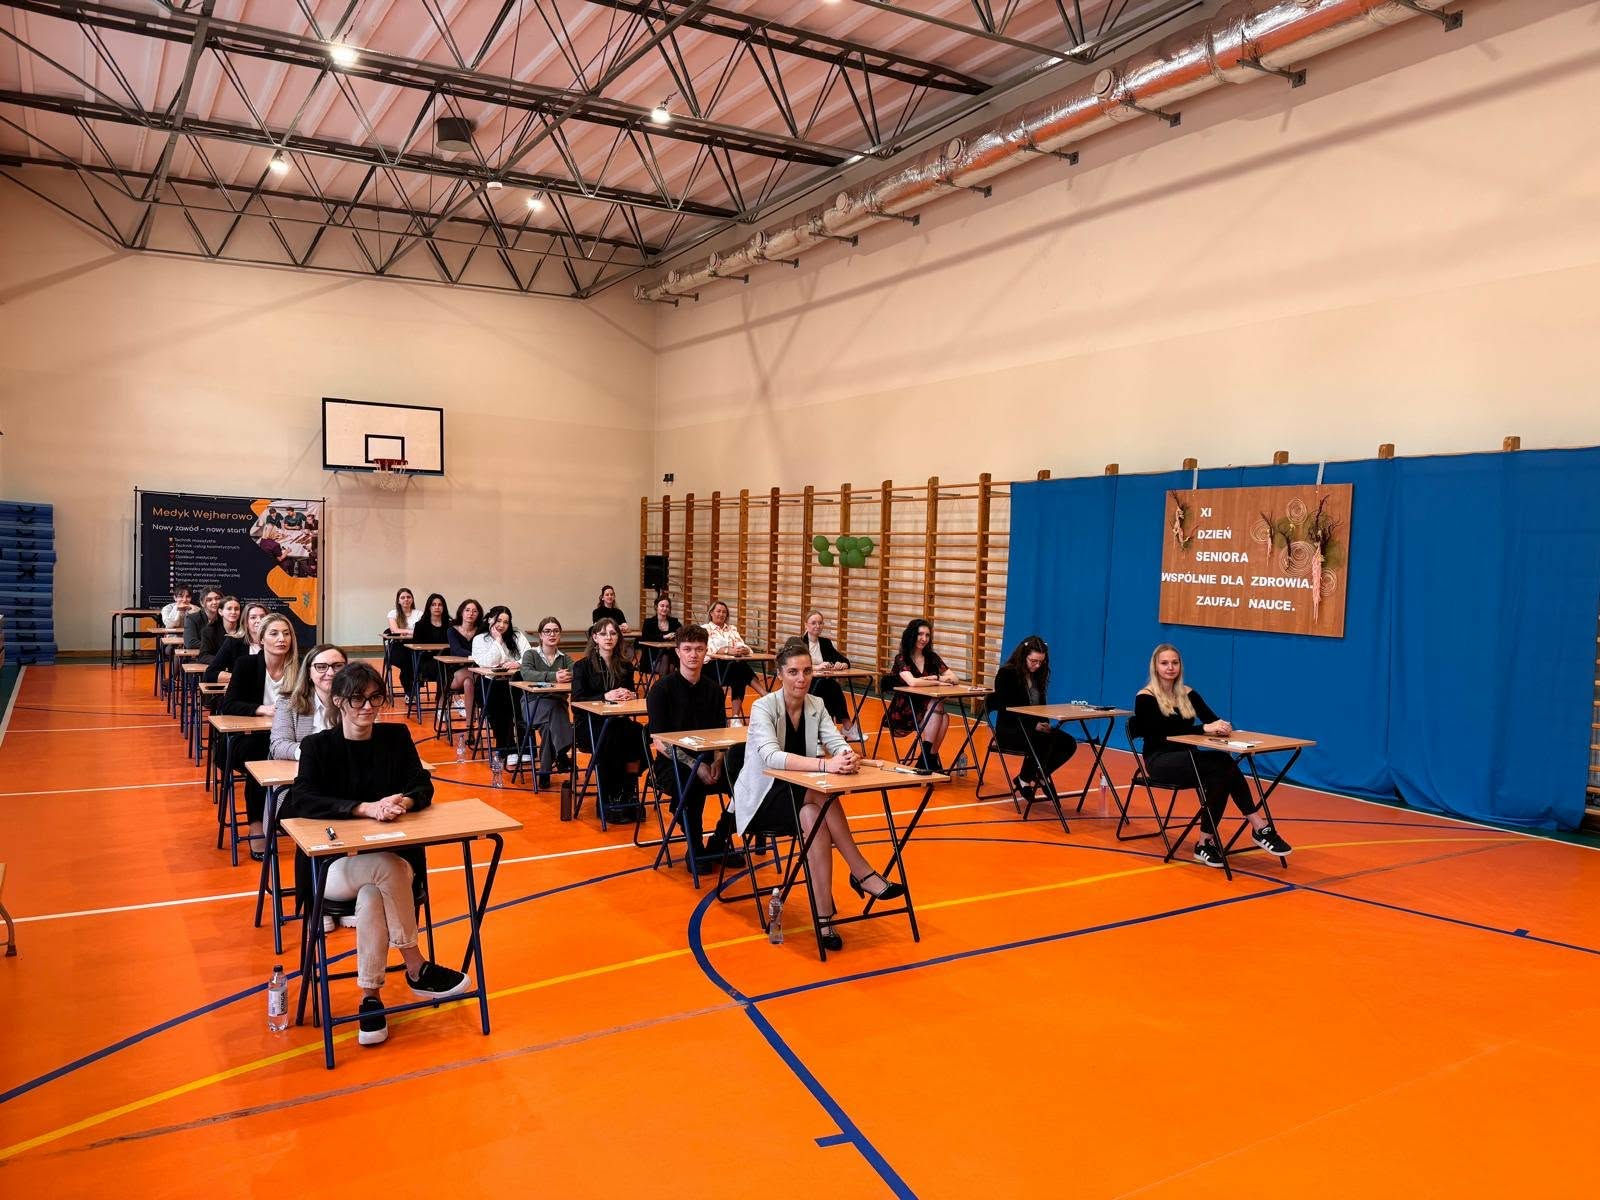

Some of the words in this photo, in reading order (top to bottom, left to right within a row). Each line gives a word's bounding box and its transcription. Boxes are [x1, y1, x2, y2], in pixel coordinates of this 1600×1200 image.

[152, 507, 190, 519] Medyk
[192, 509, 253, 520] Wejherowo
[1200, 507, 1212, 518] XI
[152, 524, 173, 532] Nowy
[1197, 527, 1232, 540] DZIEŃ
[1196, 551, 1249, 563] SENIORA
[1161, 571, 1217, 585] WSPÓLNIE
[1220, 574, 1244, 586] DLA
[1250, 576, 1314, 589] ZDROWIA.
[1196, 596, 1240, 608] ZAUFAJ
[1248, 599, 1296, 612] NAUCE.
